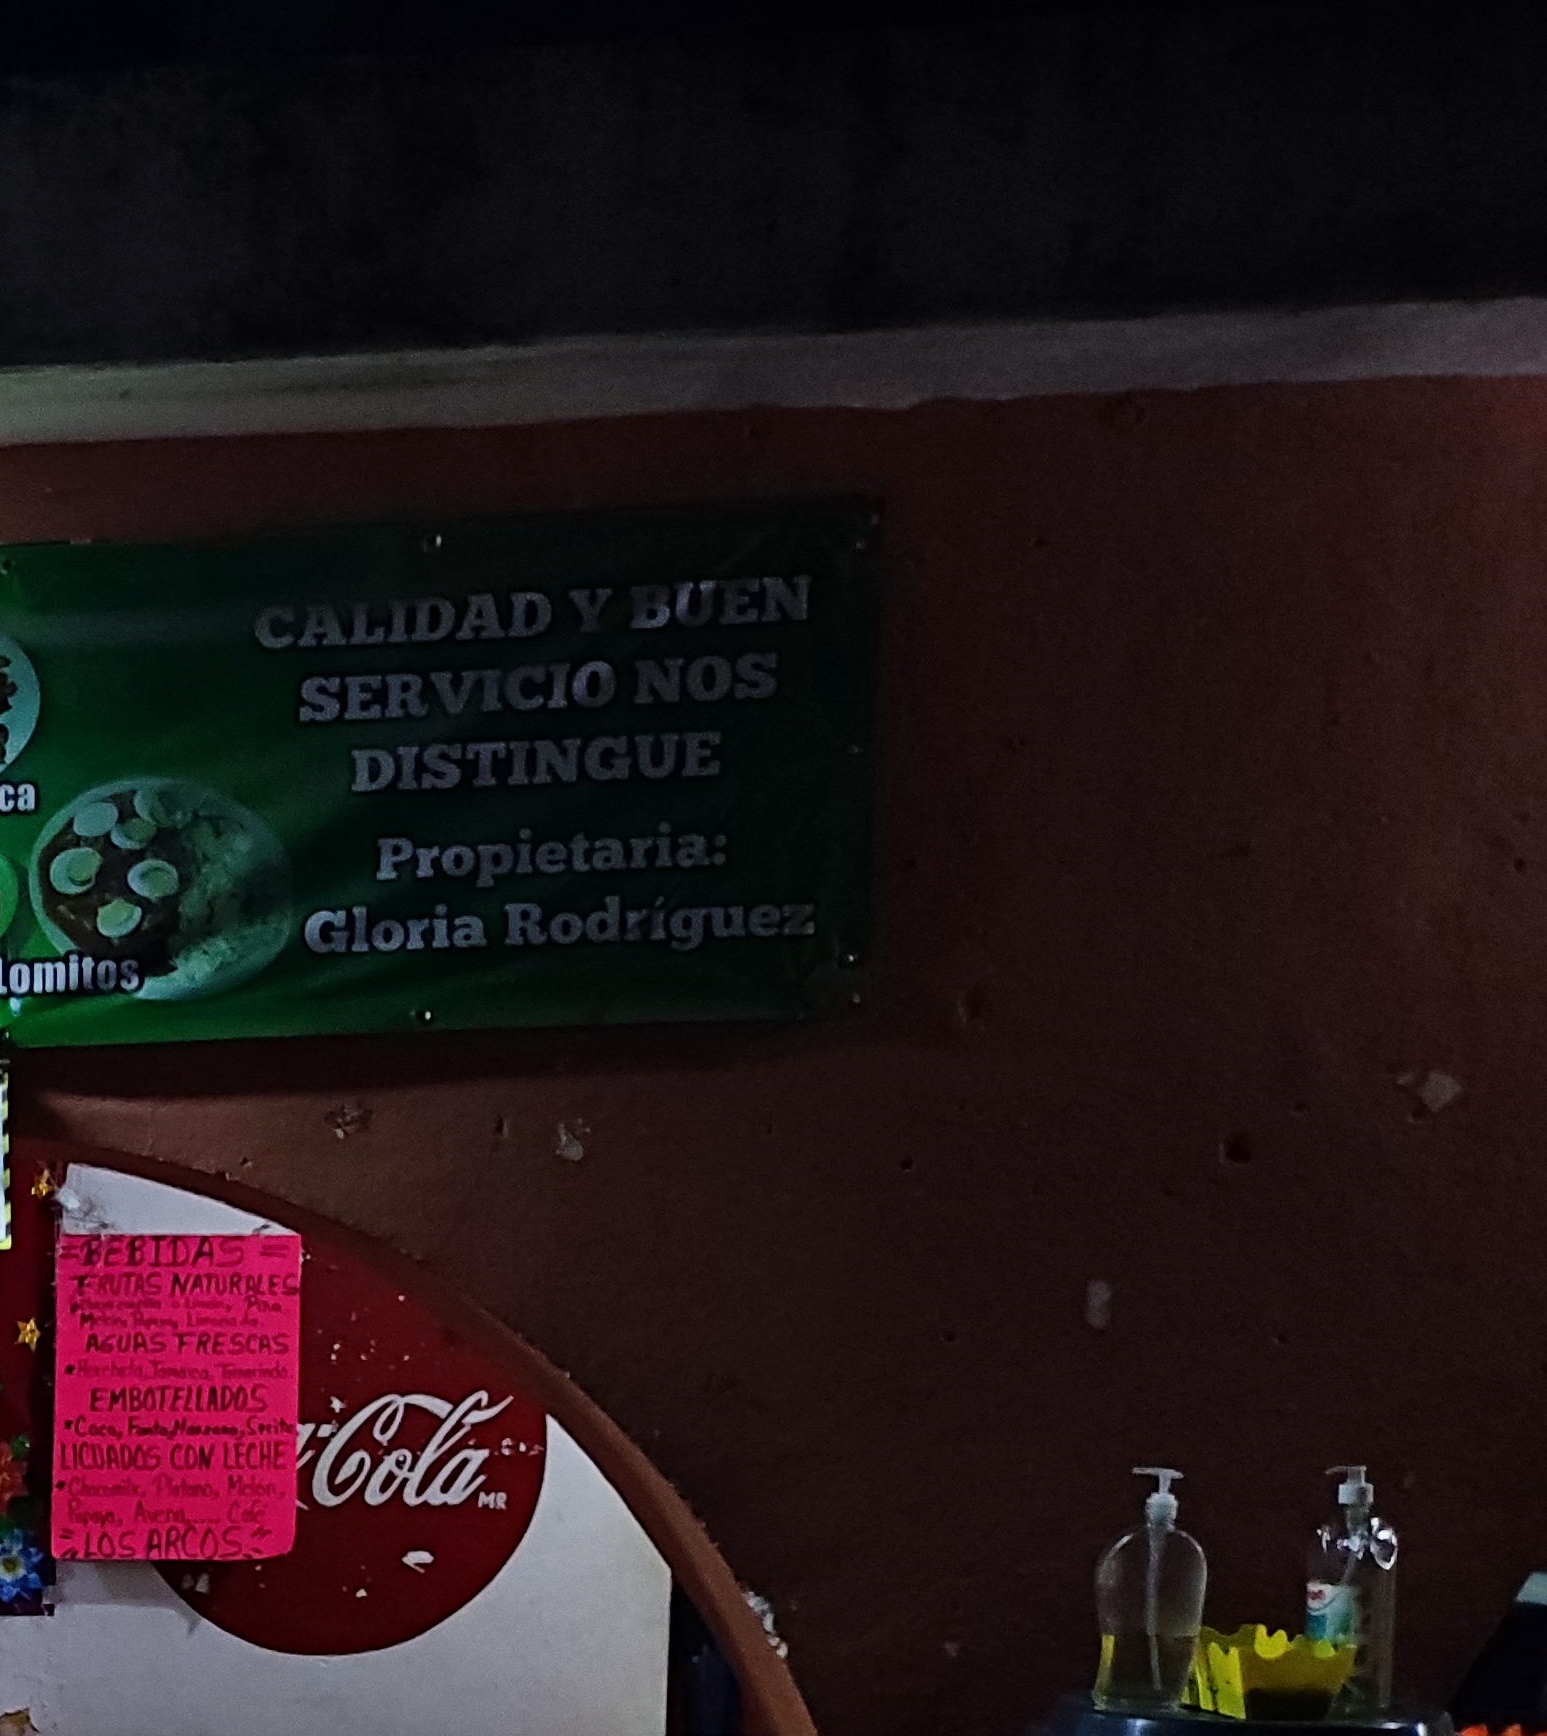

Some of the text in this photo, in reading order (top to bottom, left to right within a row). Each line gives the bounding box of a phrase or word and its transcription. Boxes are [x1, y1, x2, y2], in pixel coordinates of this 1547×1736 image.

[253, 575, 812, 650] CALIDAD Y BUEN
[299, 652, 778, 723] SERVICIO NOS
[351, 730, 722, 793] DISTINGUE
[376, 821, 727, 888] Propietaria:
[304, 896, 816, 954] Gloria Rodríguez
[79, 1237, 245, 1267] BEBIDAS
[68, 1272, 299, 1296] FRUTAS NATURALES
[85, 1332, 289, 1354] AGUAS FRESCAS
[90, 1386, 267, 1412] EMBOTELLADOS
[61, 1441, 289, 1471] LICUADOS CON LECHE
[478, 1491, 507, 1510] MR
